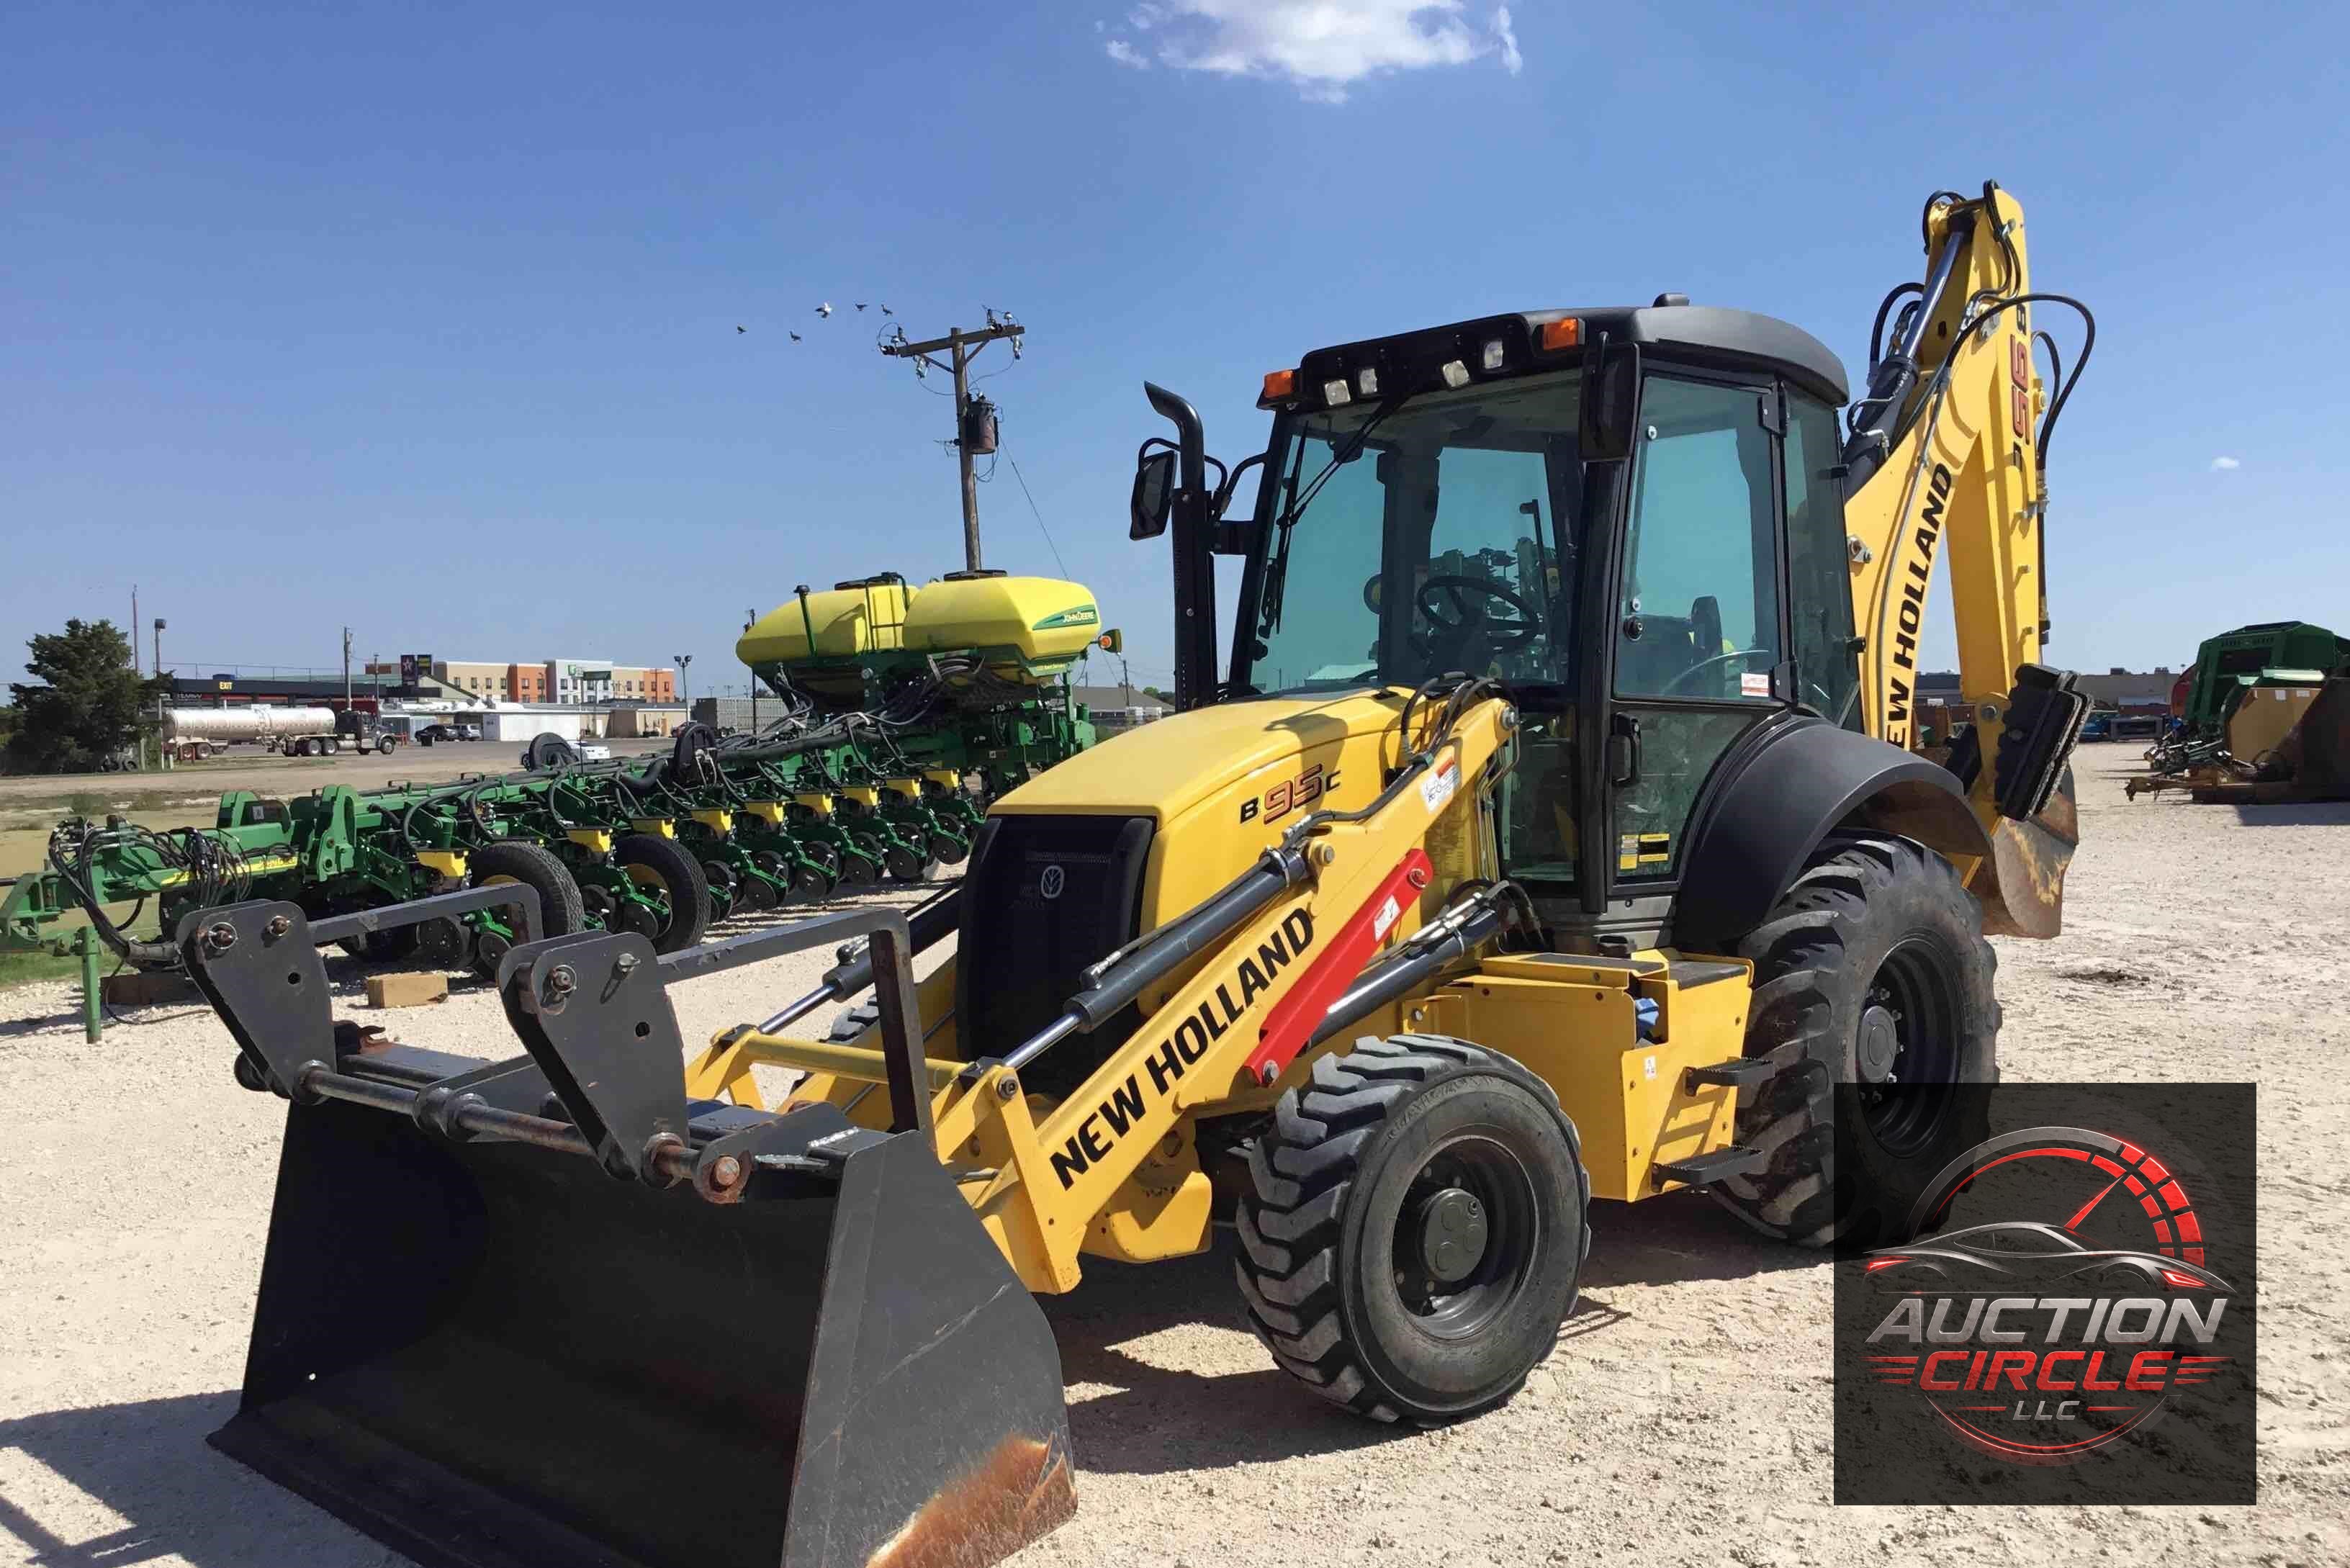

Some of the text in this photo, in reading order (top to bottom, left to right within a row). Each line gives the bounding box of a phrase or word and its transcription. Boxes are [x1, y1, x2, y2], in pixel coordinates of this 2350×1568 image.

[1893, 461, 1953, 670] HOLLAND
[219, 681, 233, 690] EXIT
[1050, 907, 1315, 1191] NEW HOLLAND
